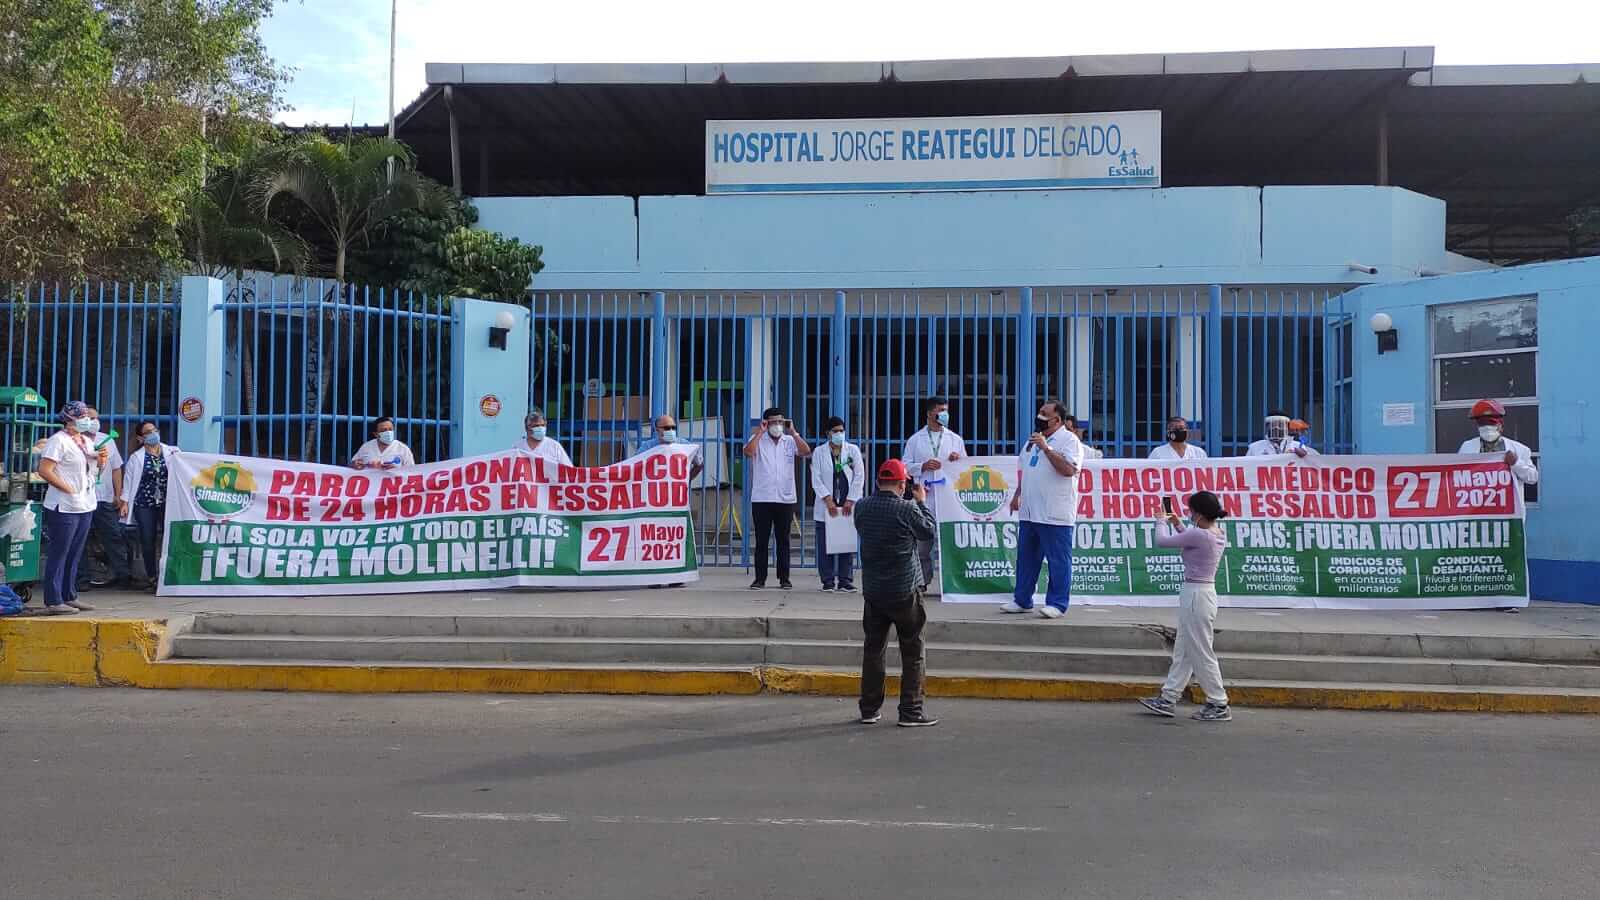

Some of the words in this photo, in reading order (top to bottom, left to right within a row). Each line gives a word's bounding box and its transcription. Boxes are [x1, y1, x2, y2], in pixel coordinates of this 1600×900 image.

[714, 131, 824, 163] HOSPITAL
[830, 130, 894, 162] JORGE
[902, 127, 1015, 161] REATEGUI
[1023, 124, 1121, 157] DELGADO
[1109, 166, 1154, 177] EsSalud
[270, 470, 370, 497] PARO
[379, 457, 549, 496] NACIONAL
[1101, 467, 1250, 493] NACIONAL
[1257, 462, 1376, 493] MÉDICO
[1453, 469, 1511, 490] Mayo
[1394, 471, 1444, 509] 27
[197, 486, 249, 508] sinamssop
[266, 496, 310, 521] DE
[320, 498, 365, 522] 24
[375, 485, 491, 520] HORAS
[501, 484, 538, 510] EN
[550, 482, 688, 511] ESSALUD
[960, 489, 1004, 505] sinamssop
[1456, 488, 1507, 508] 2021
[1077, 495, 1095, 519] 4
[1217, 493, 1242, 517] N
[1251, 493, 1376, 519] ESSALUD
[191, 524, 243, 544] UNA
[251, 528, 317, 547] SOLA
[320, 528, 371, 546] VOZ
[375, 525, 405, 544] EN
[410, 519, 476, 541] TODO
[483, 519, 507, 538] EL
[511, 514, 569, 538] PAÍS:
[640, 523, 684, 542] Mayo
[954, 523, 1000, 549] UNA
[1110, 523, 1137, 549] EN
[1236, 520, 1291, 548] PAÍS:
[1295, 522, 1376, 552] ¡FUERA
[1380, 519, 1510, 550] MOLINELLI!
[587, 526, 630, 562] 27
[641, 544, 681, 561] 2021
[200, 546, 339, 581] ¡FUERA
[350, 539, 556, 576] MOLINELLI!
[966, 561, 1013, 569] VACUNA
[1108, 556, 1123, 564] DE
[1246, 555, 1280, 564] FALTA
[1282, 556, 1295, 565] DE
[1331, 557, 1383, 566] INDICIOS
[1386, 558, 1403, 566] DE
[1438, 556, 1503, 565] CONDUCTA
[965, 569, 1016, 578] INEFICAZ
[1072, 565, 1116, 573] PITALES
[1241, 564, 1281, 573] CAMAS
[1283, 565, 1299, 574] UCI
[1432, 565, 1508, 575] DESAFIANTE,
[1150, 575, 1166, 584] por
[1238, 575, 1244, 584] y
[1246, 573, 1304, 583] ventiladores
[1334, 576, 1348, 584] en
[1351, 575, 1402, 584] contratos
[1459, 573, 1505, 583] indiferente
[1507, 572, 1516, 582] al
[1070, 581, 1104, 591] édicos
[1247, 582, 1296, 591] mecánicos
[1338, 583, 1400, 593] millonarios
[1424, 584, 1447, 593] dolor
[1448, 584, 1459, 592] de
[1460, 583, 1472, 592] los
